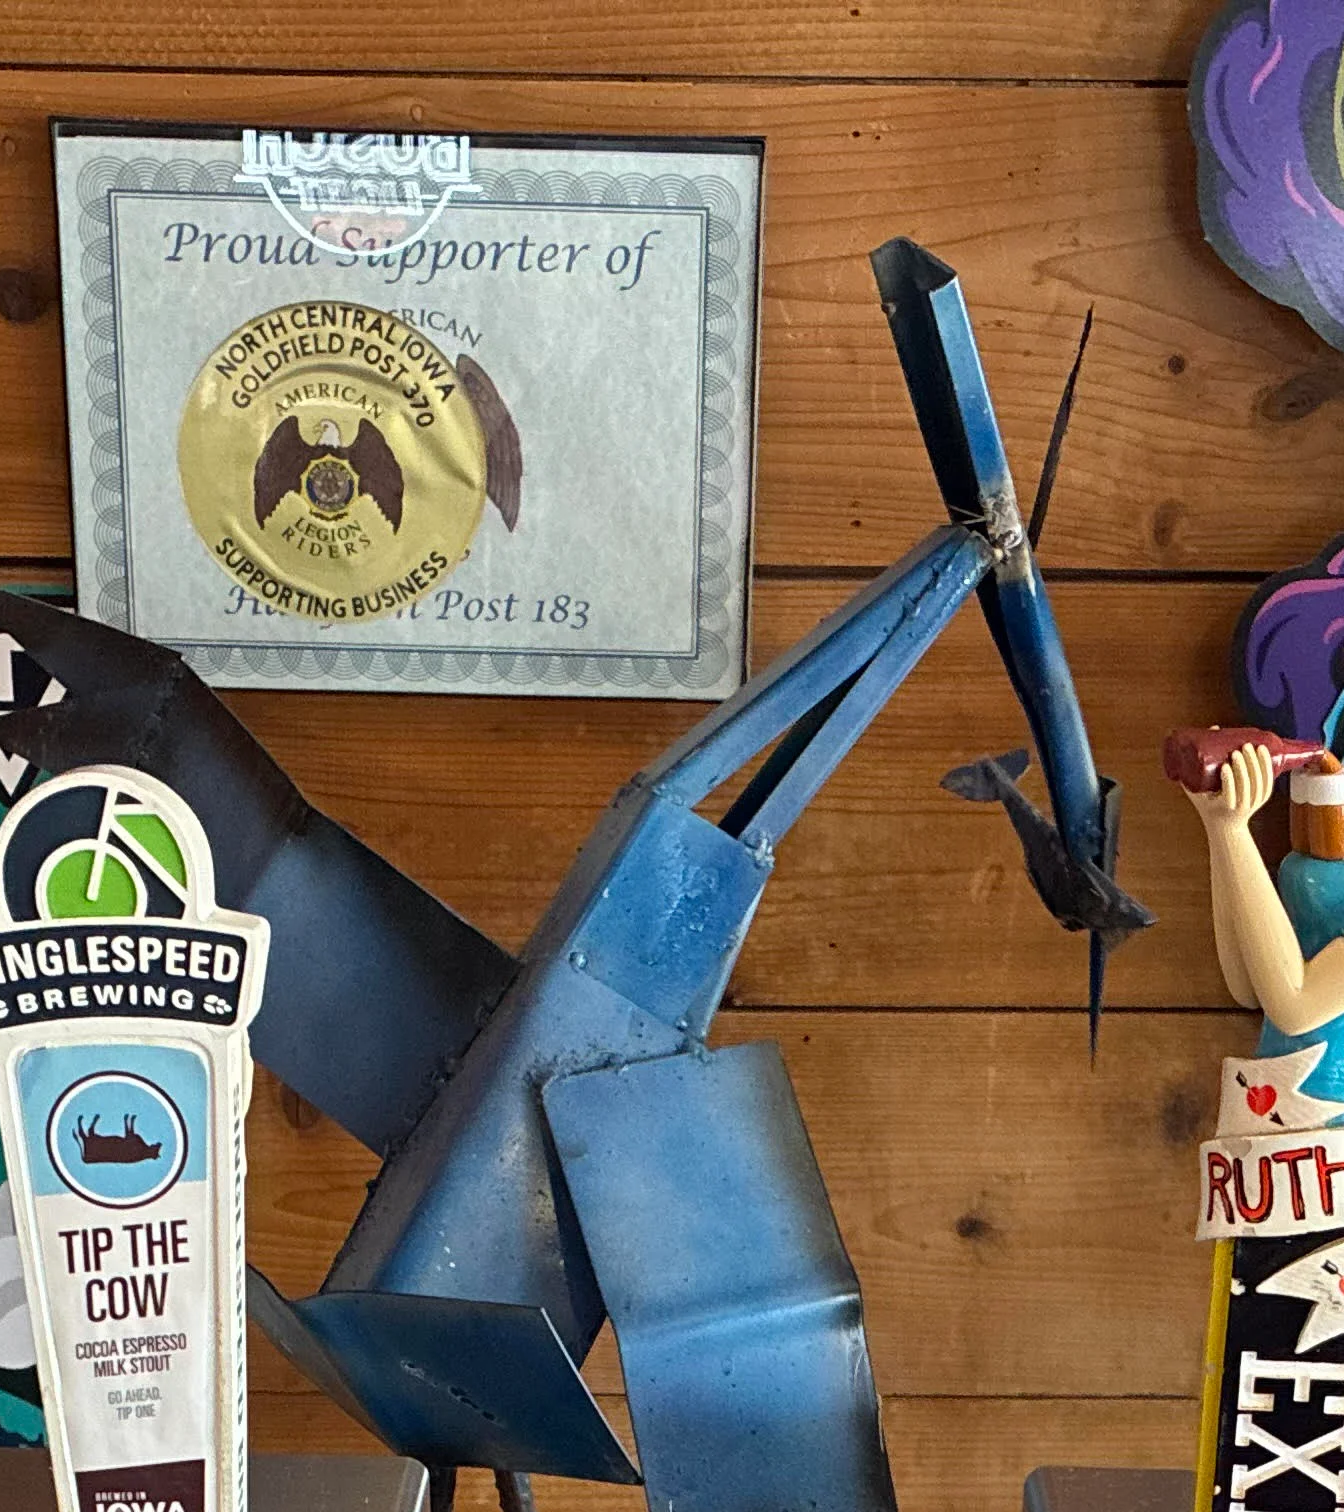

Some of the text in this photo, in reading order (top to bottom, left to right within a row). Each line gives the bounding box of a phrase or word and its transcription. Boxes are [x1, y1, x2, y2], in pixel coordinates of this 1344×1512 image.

[163, 221, 661, 290] Proud Supporter of
[216, 306, 457, 402] NORTH CENTRAL IOWA
[232, 333, 435, 428] GOLDFIELD POST 370
[274, 383, 384, 420] AMERICAN
[281, 526, 372, 559] RIDERS
[294, 517, 362, 543] LEGION
[216, 538, 346, 618] SUPPORTING
[352, 551, 448, 617] BUSINESS
[433, 590, 515, 624] Post
[531, 597, 590, 630] 183
[16, 985, 194, 1015] BREWING
[58, 1219, 190, 1275] TIP THE
[84, 1271, 169, 1323] COW
[76, 1332, 187, 1360] COCOA ESPRESSO
[94, 1354, 171, 1378] MILK STOUT
[108, 1390, 122, 1405] GO
[117, 1403, 156, 1420] TIP ONE
